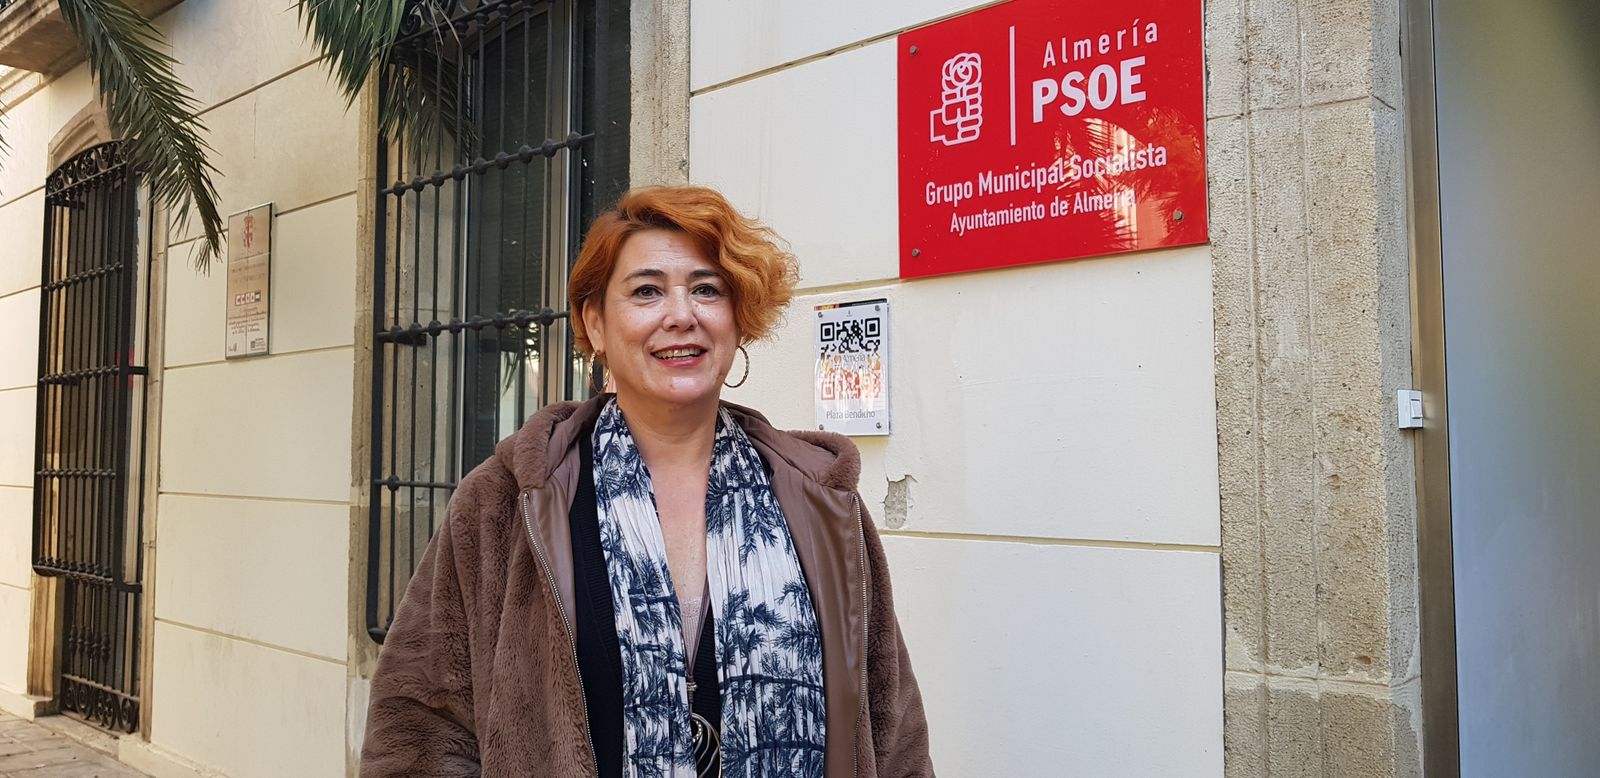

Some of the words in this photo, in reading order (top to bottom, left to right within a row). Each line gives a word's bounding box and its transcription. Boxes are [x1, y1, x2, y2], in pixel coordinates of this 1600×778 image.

[1042, 18, 1158, 69] Almería
[1032, 55, 1147, 124] PSOE
[925, 180, 974, 208] Grupo
[978, 157, 1065, 197] Municipal
[1070, 142, 1168, 181] Socialista
[950, 201, 1046, 237] Ayuntamiento
[1049, 195, 1070, 218] de
